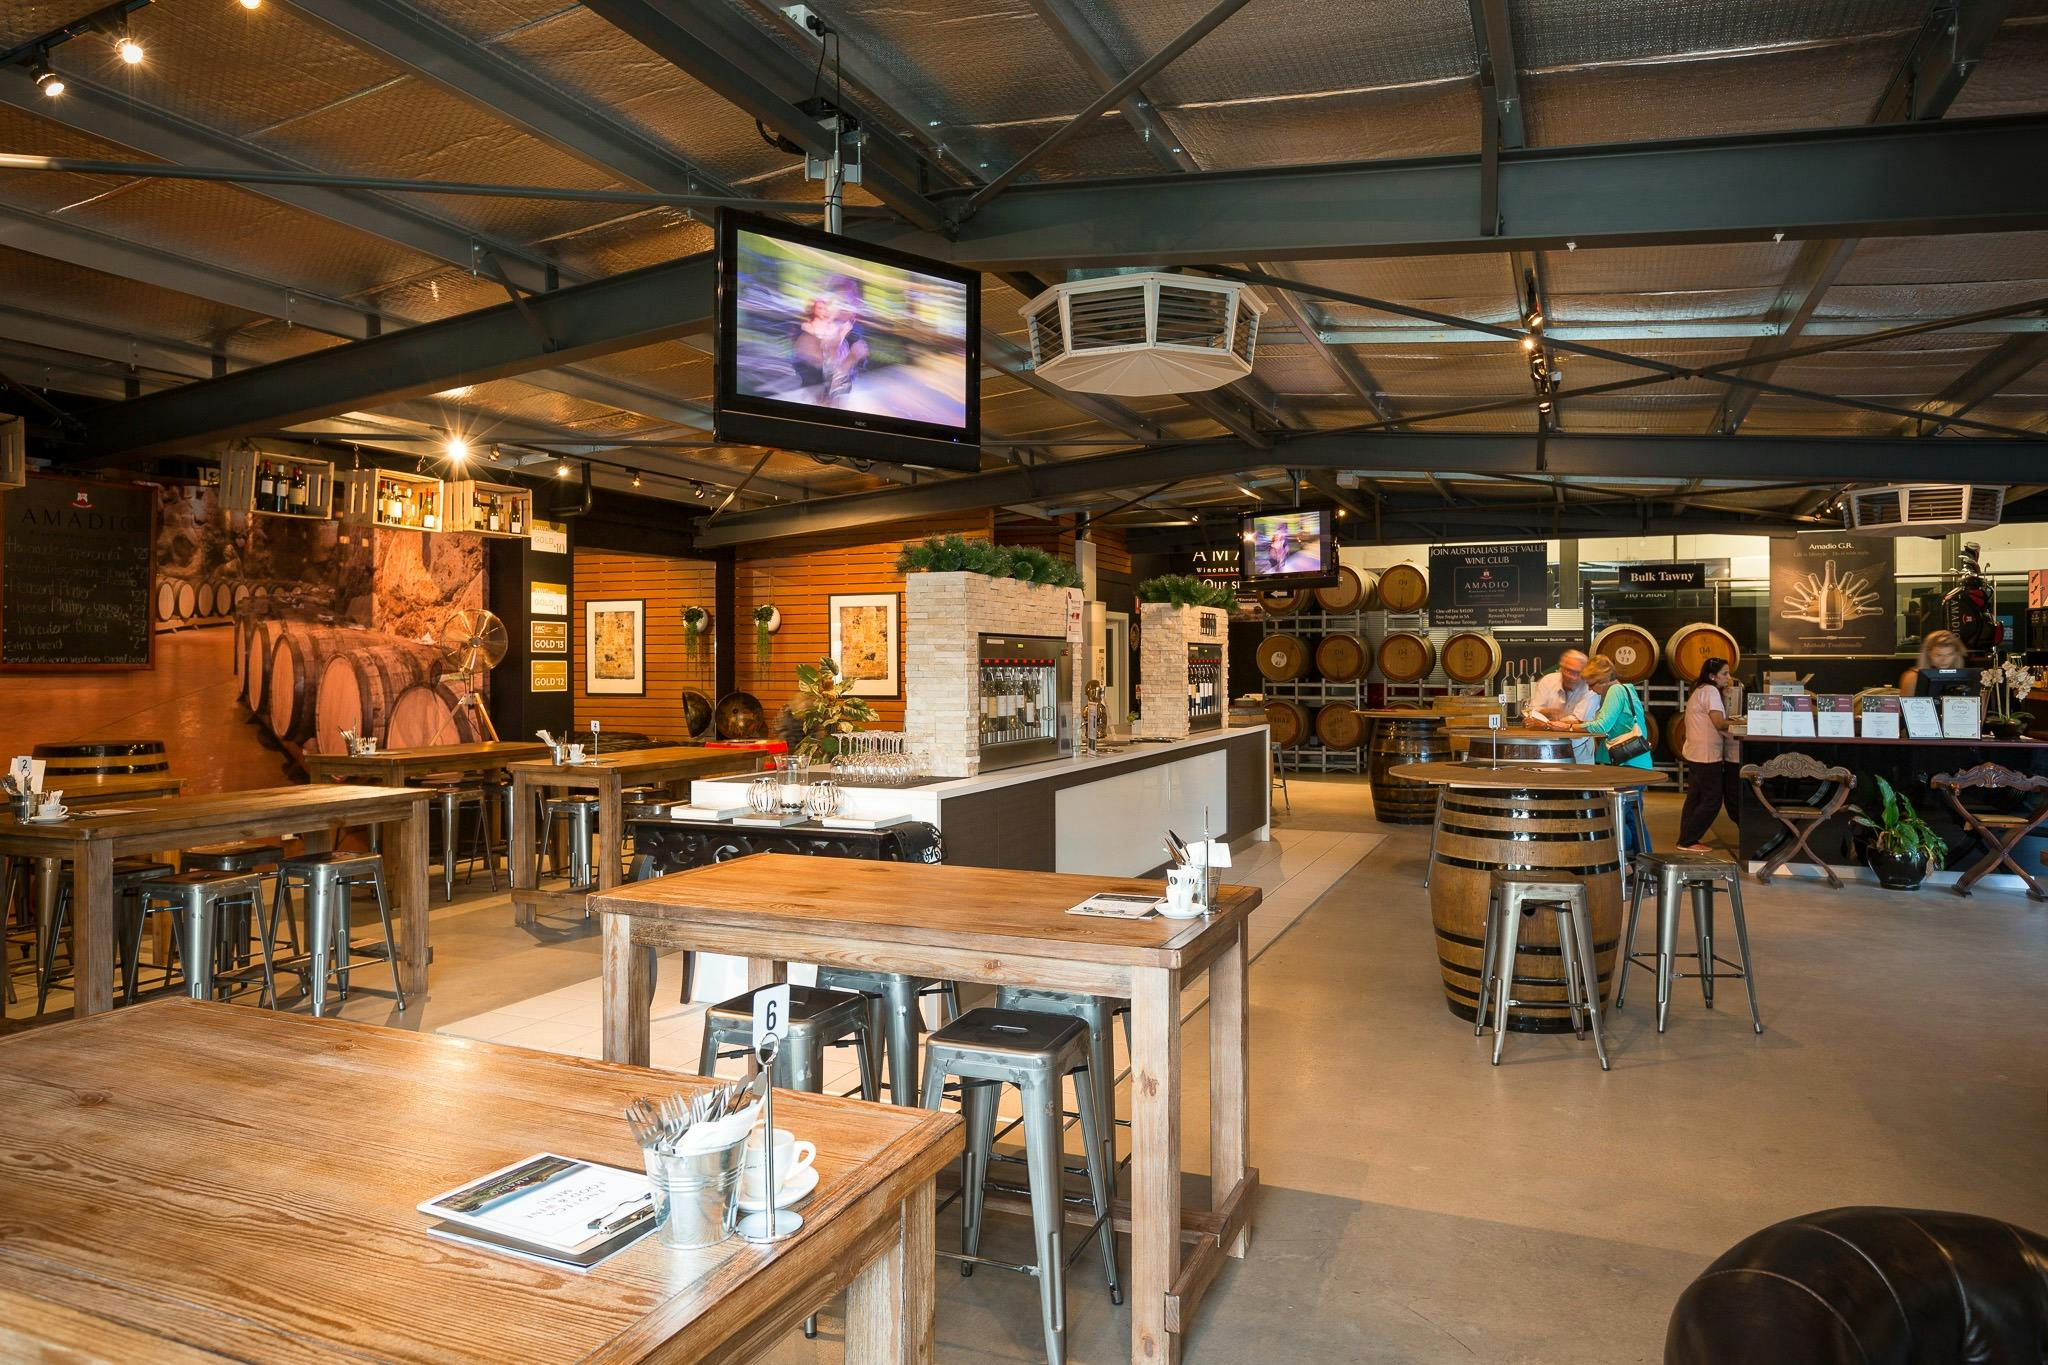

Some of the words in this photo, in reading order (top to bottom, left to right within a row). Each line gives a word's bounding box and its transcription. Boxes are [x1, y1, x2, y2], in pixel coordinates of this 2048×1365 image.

[534, 536, 554, 545] GOLD
[1430, 547, 1449, 557] JOIN
[1500, 545, 1519, 553] BEST
[1520, 544, 1546, 553] VALUE
[1192, 550, 1240, 562] AM
[1465, 557, 1486, 565] WINE
[1487, 556, 1509, 564] CLUB
[1631, 572, 1656, 582] Bulk
[1658, 571, 1694, 582] Tawny
[1464, 581, 1509, 589] AMADIO
[534, 640, 555, 648] GOLD
[534, 677, 555, 686] GOLD
[22, 759, 28, 769] 2
[766, 1000, 777, 1031] 6
